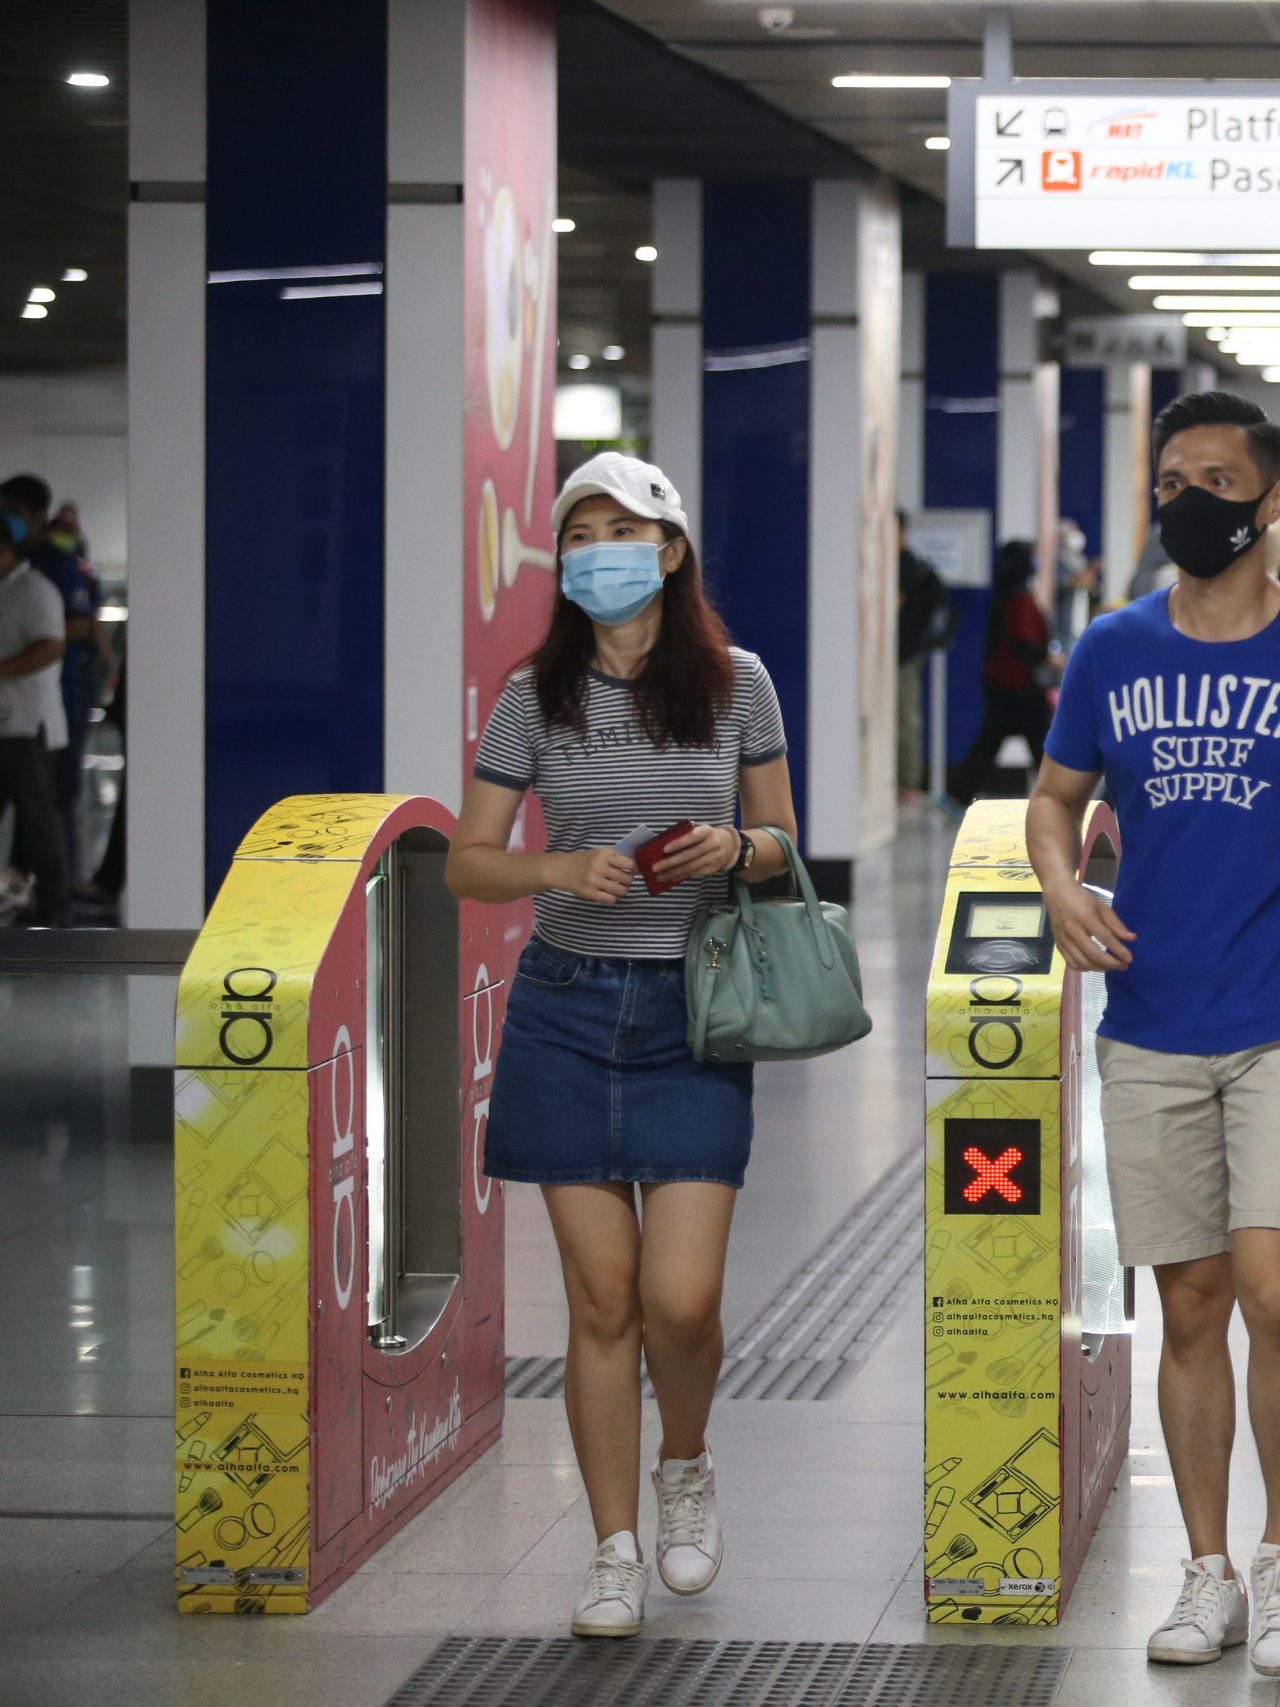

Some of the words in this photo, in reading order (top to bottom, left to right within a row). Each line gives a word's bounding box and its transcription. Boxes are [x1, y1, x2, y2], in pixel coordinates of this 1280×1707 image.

[1090, 160, 1199, 183] rapidKL
[1152, 735, 1256, 772] SURF
[1144, 772, 1272, 810] SUPPLY
[946, 1328, 988, 1336] alhaalfa
[194, 1369, 215, 1377] Alha
[218, 1370, 238, 1378] Alfa
[241, 1371, 288, 1379] Cosmetics
[938, 1390, 1056, 1400] www.alhaalfa.com
[193, 1399, 235, 1408] alhaalfa
[183, 1462, 300, 1473] www.alhaalfa.com
[1008, 1583, 1033, 1591] xerox
